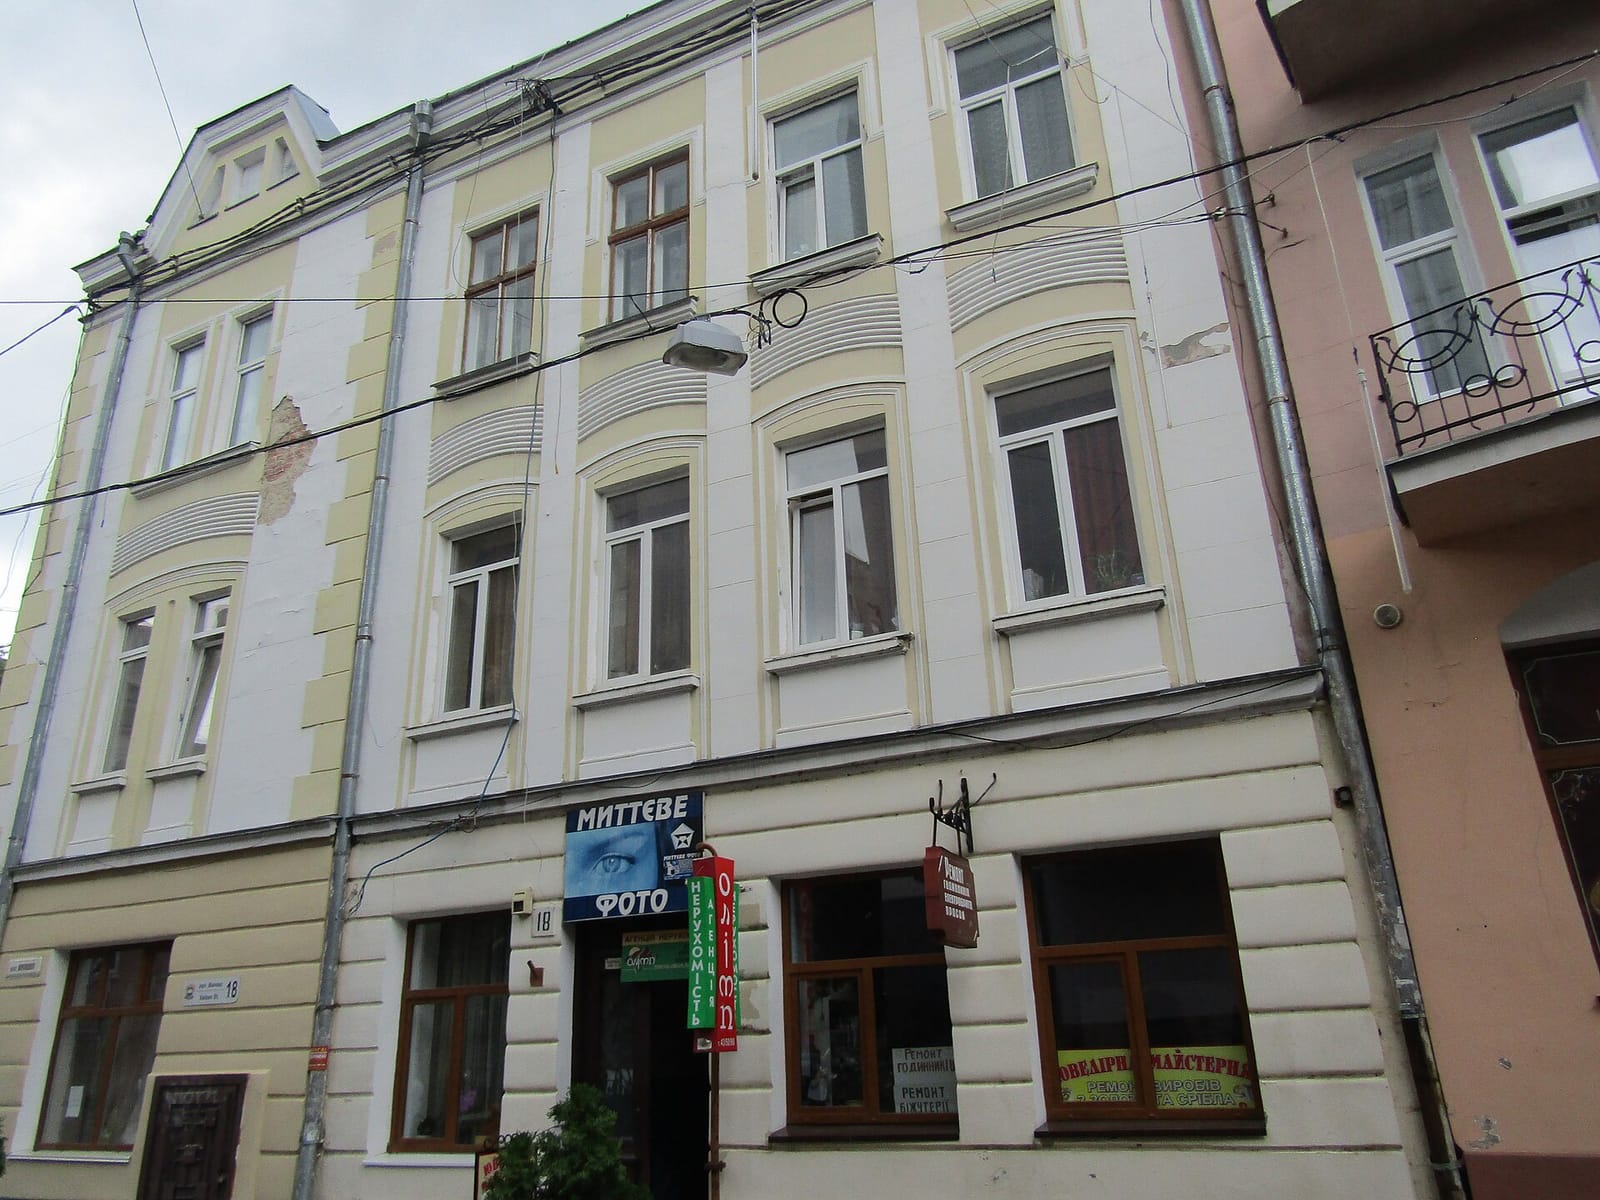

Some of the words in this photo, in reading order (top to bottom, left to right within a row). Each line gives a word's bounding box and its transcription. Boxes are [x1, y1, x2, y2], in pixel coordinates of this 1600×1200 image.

[577, 794, 689, 831] МИТТЄВЕ
[596, 888, 668, 917] ФОТО
[537, 911, 551, 931] 18
[691, 881, 704, 1026] НЕРУХОМІСТЬ
[708, 899, 716, 1008] АГЕНЦІЯ
[226, 980, 238, 998] 18
[902, 1086, 945, 1099] РЕМОНТ
[1177, 1093, 1236, 1106] СРІБЛА
